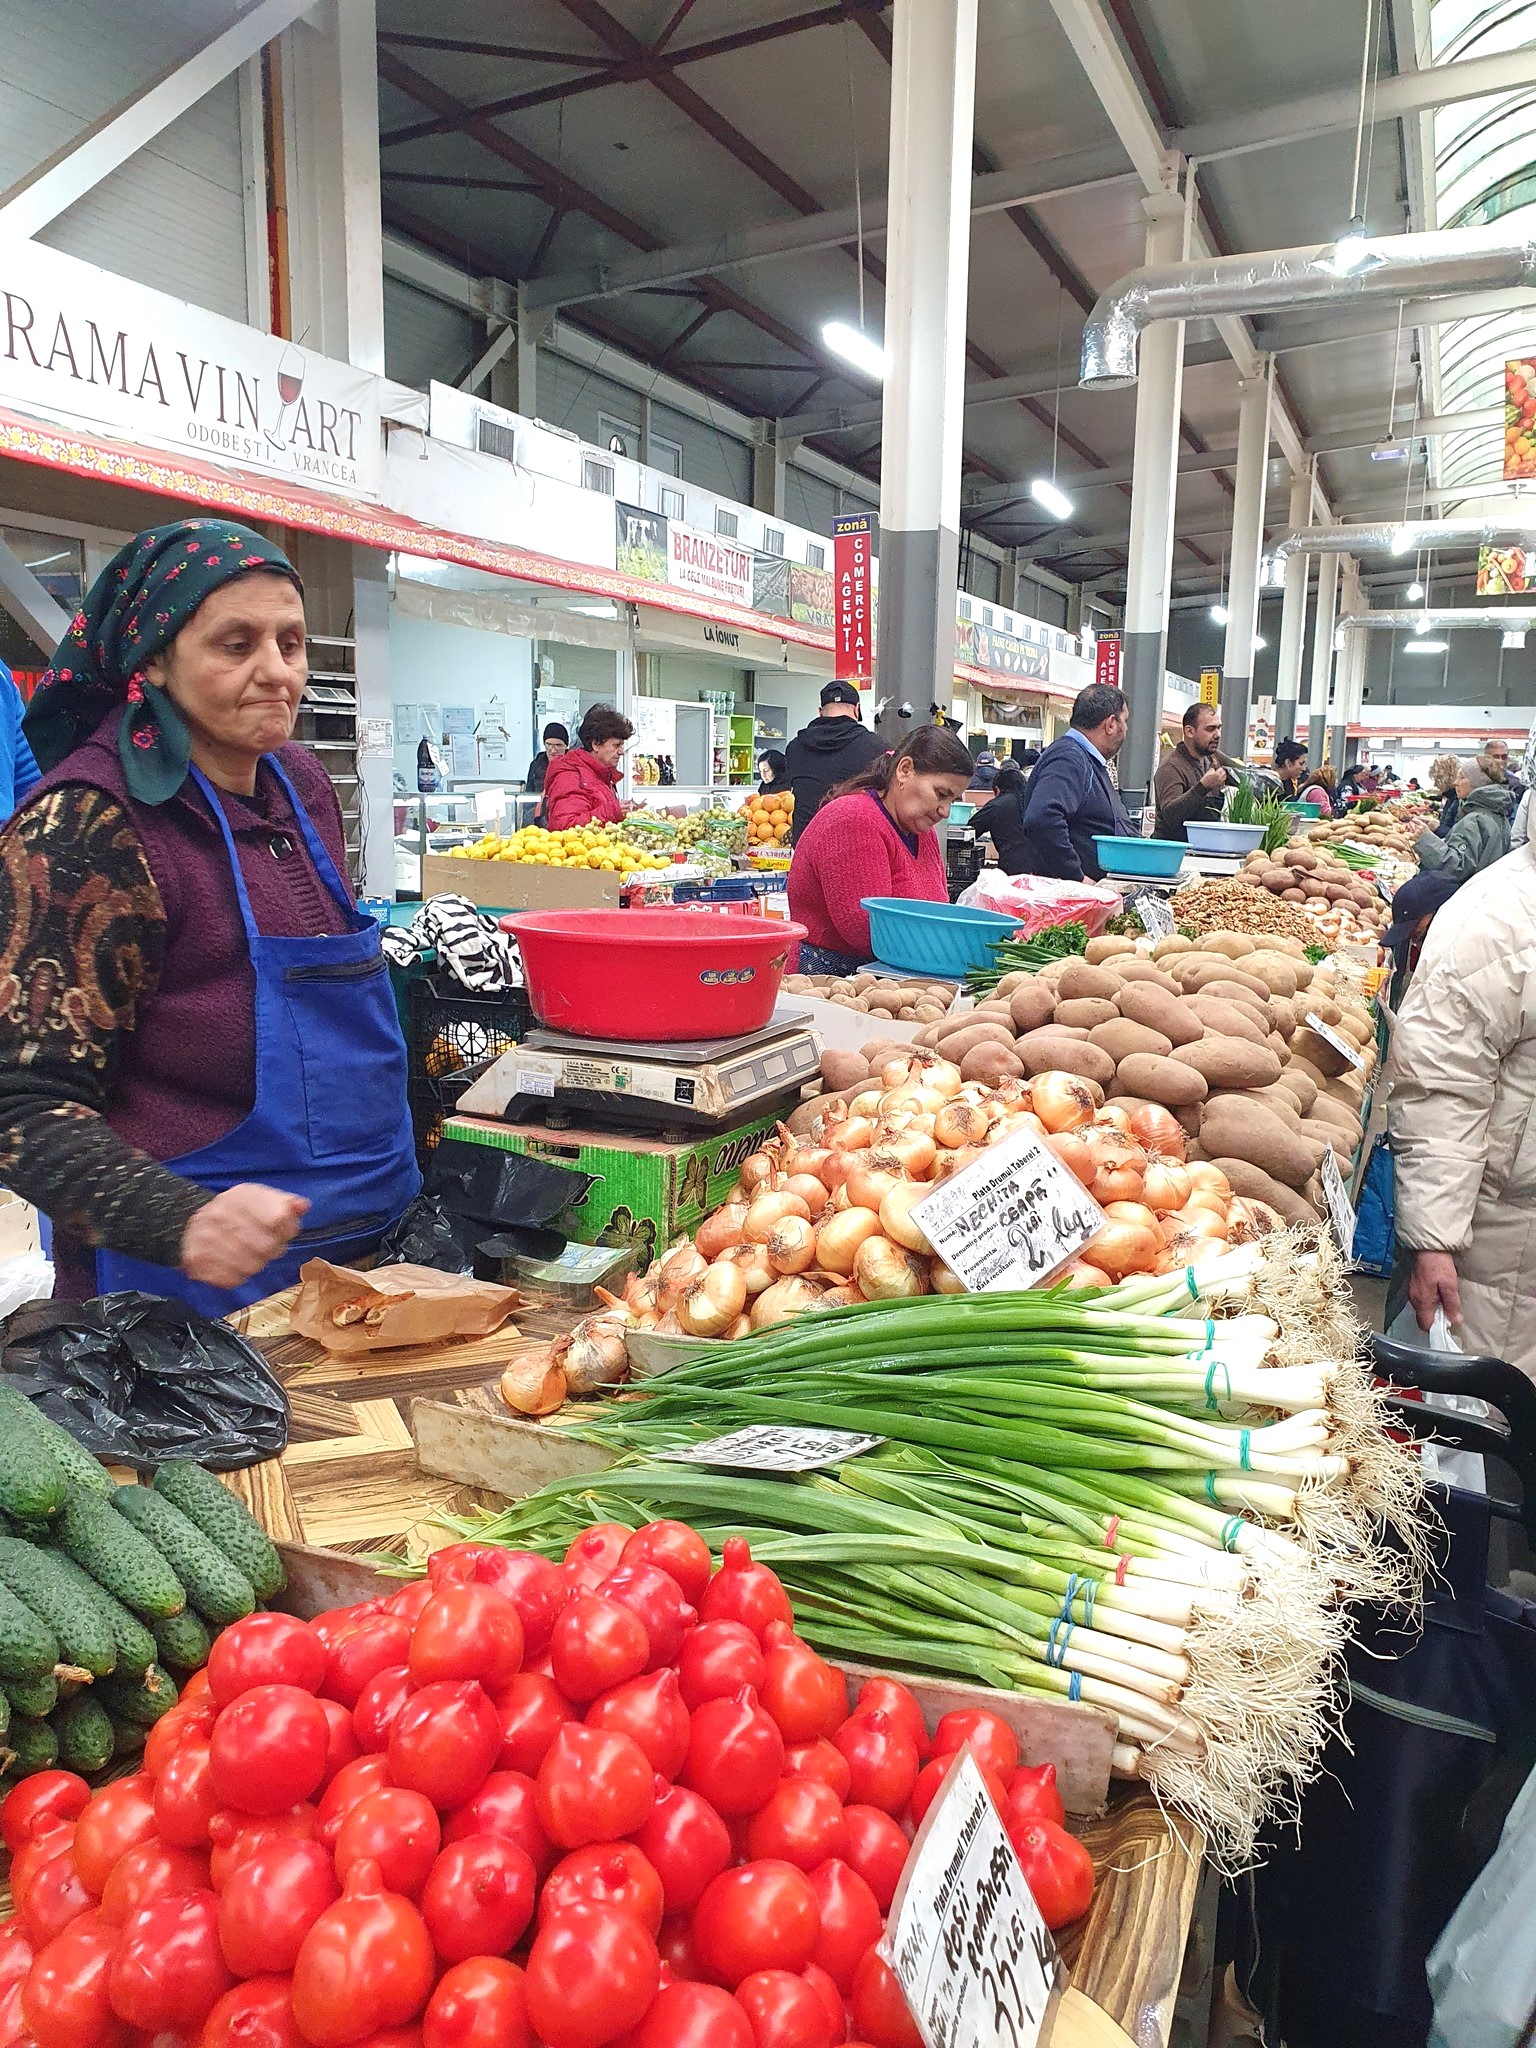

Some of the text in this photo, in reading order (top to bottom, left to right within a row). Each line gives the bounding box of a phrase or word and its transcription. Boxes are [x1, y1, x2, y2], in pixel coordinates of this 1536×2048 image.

[293, 452, 357, 484] VRANCEA
[837, 518, 868, 532] zonă
[674, 532, 750, 582] BRANZETURI
[688, 570, 701, 584] CELE
[853, 538, 865, 674] COMERCIALI
[704, 627, 715, 642] LA
[989, 1167, 1013, 1188] Drumul
[1010, 1150, 1036, 1171] Taberei
[1033, 1146, 1040, 1154] 2
[939, 1229, 958, 1245] Nume:
[951, 1222, 999, 1261] Denumire produs:
[944, 1838, 965, 1889] Drumul
[960, 1799, 983, 1847] Taberei
[979, 1791, 987, 1810] 2
